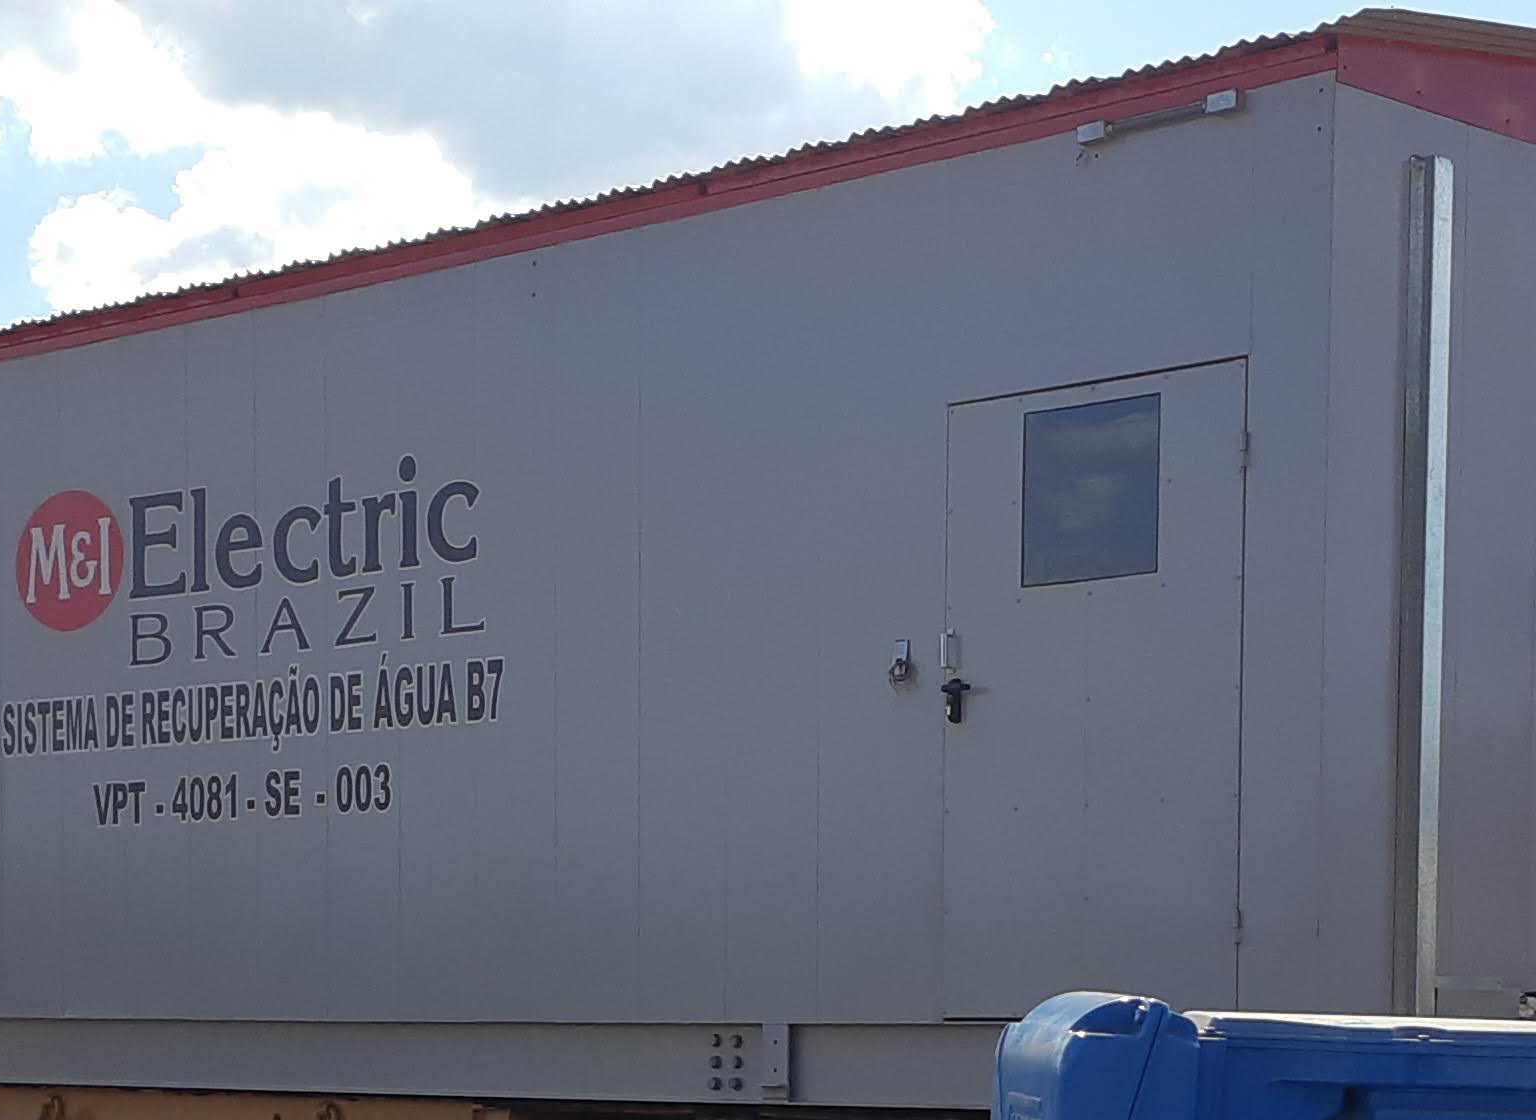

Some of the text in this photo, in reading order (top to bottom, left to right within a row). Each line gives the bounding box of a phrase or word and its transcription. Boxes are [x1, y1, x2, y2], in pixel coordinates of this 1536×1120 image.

[25, 454, 481, 604] M&I Electric
[128, 576, 486, 667] BRAZIL
[2, 653, 506, 757] SISTEMA DE RECUPERAÇÃO DE ÁGUA B7
[93, 782, 147, 827] VPT
[171, 774, 238, 823] 4081
[263, 770, 302, 818] SE
[335, 763, 392, 814] 003
